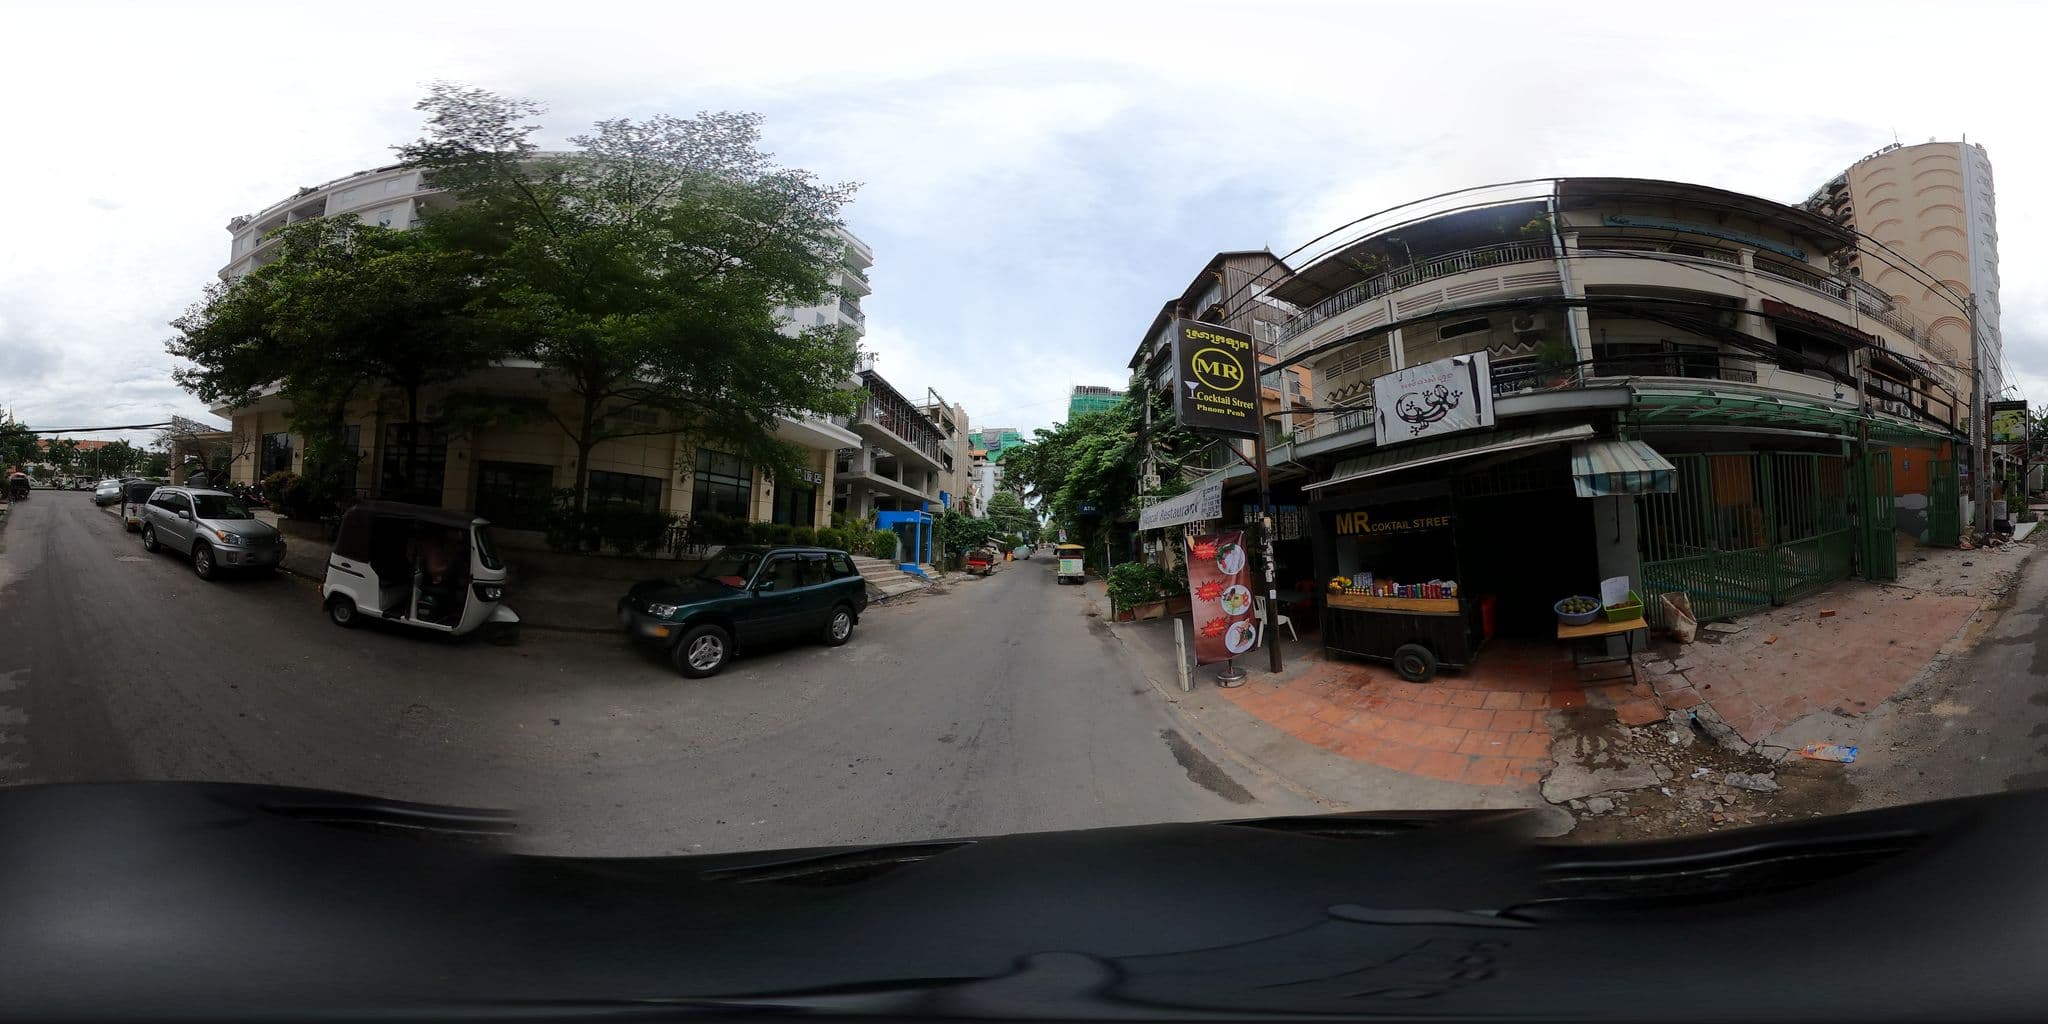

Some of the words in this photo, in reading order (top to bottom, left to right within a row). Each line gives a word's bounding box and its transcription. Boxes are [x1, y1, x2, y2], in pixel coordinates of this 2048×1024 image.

[1196, 358, 1240, 381] MR
[1196, 391, 1231, 405] Cocktail
[1232, 398, 1254, 410] Street
[1196, 403, 1225, 415] Phnom
[1226, 408, 1246, 418] Penh
[1159, 502, 1198, 521] Restaurant
[1335, 511, 1371, 536] MR
[1371, 515, 1411, 532] COKTAIL
[1412, 515, 1451, 529] STREE
